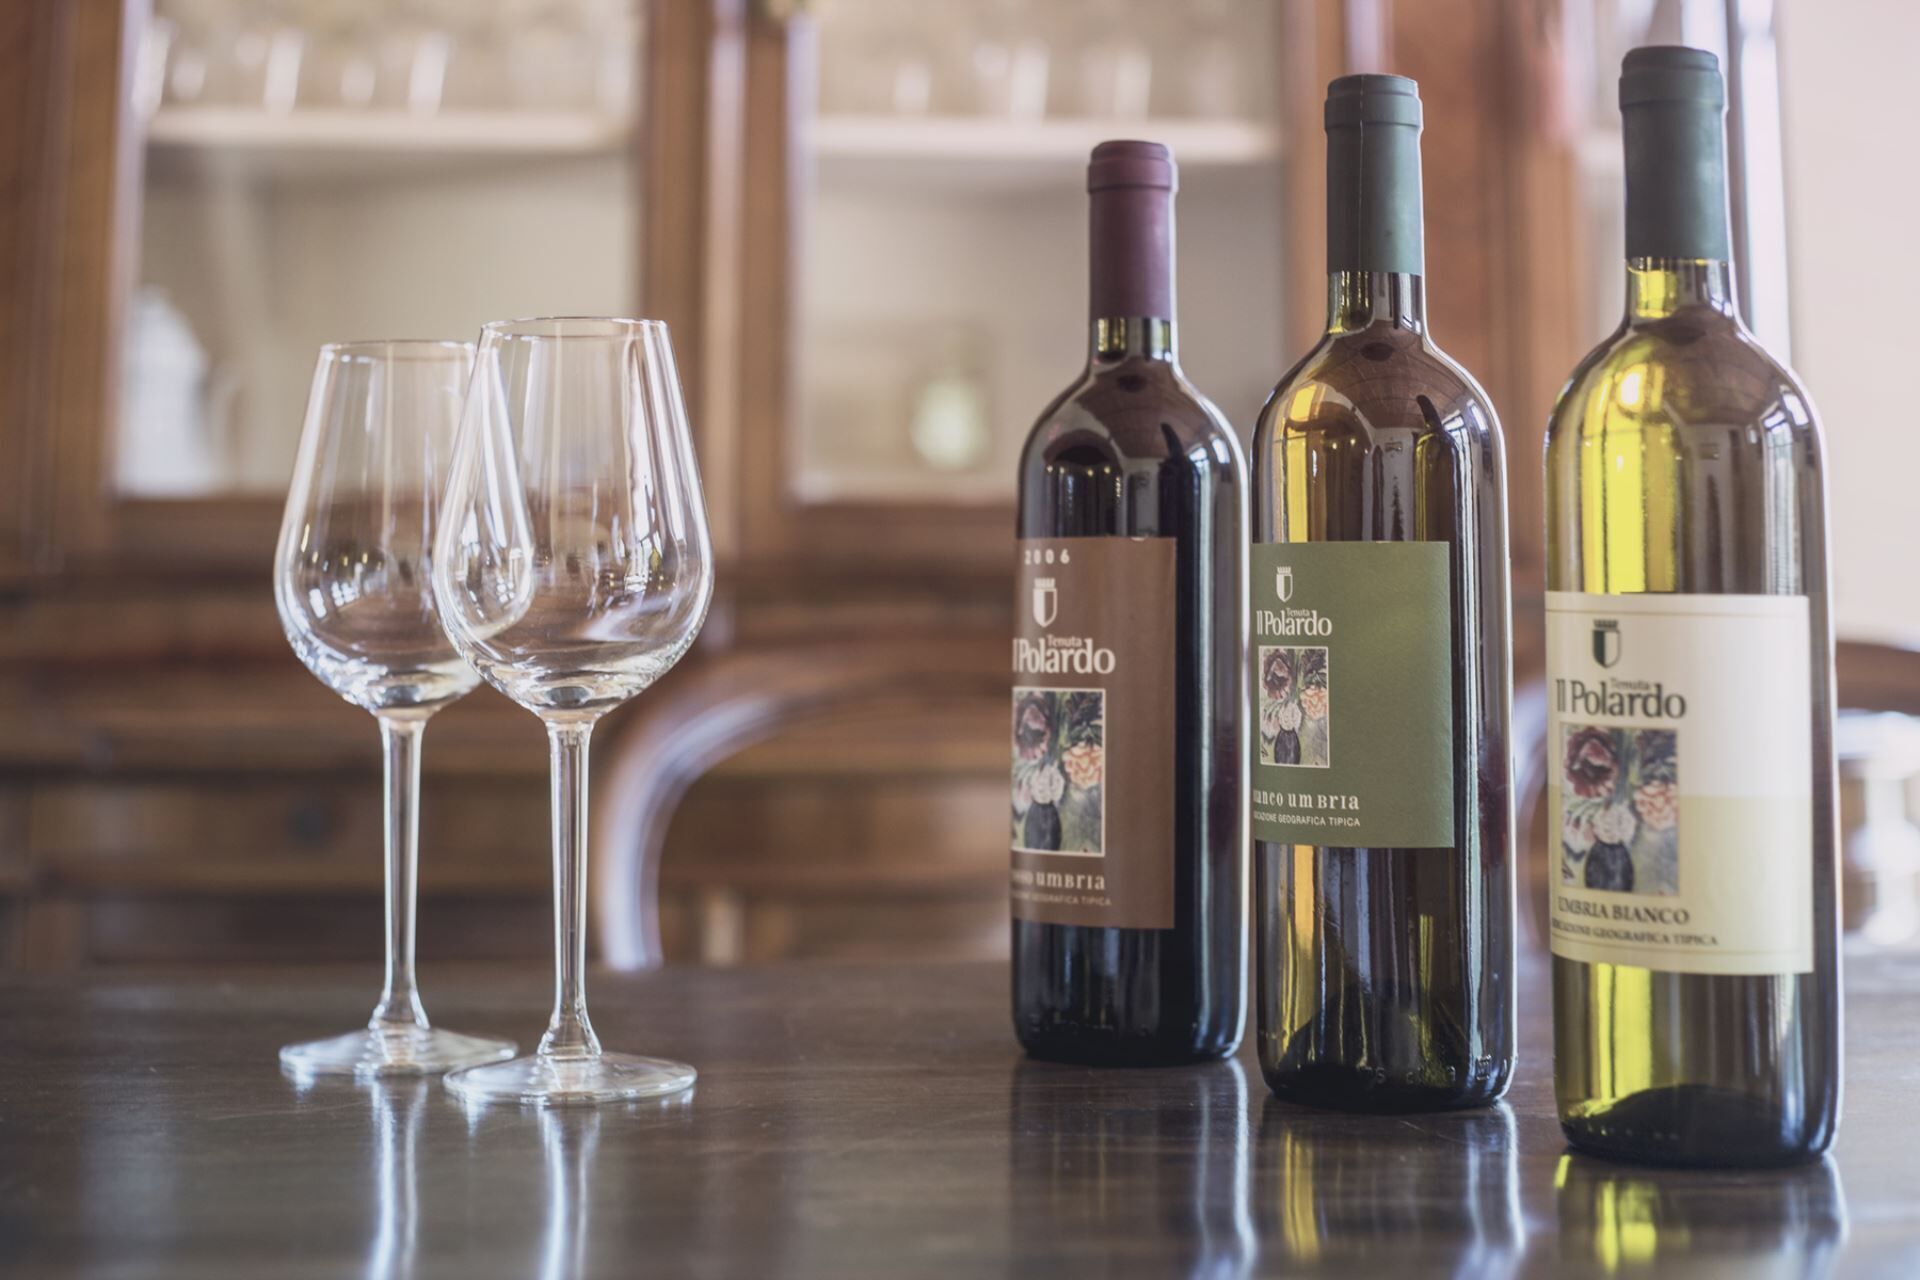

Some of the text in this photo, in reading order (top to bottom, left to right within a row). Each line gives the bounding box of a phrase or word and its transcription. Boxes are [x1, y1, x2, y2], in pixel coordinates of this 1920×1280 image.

[1024, 548, 1070, 565] 2006
[1286, 607, 1310, 617] Tenuta
[1264, 610, 1332, 636] Polardo
[1047, 634, 1082, 648] Tenuta
[1018, 637, 1116, 674] Polardo
[1570, 680, 1687, 719] Polardo
[1278, 813, 1327, 826] GEOGRAFICA
[1327, 816, 1361, 828] TIPICA
[1612, 904, 1690, 925] BIANCO
